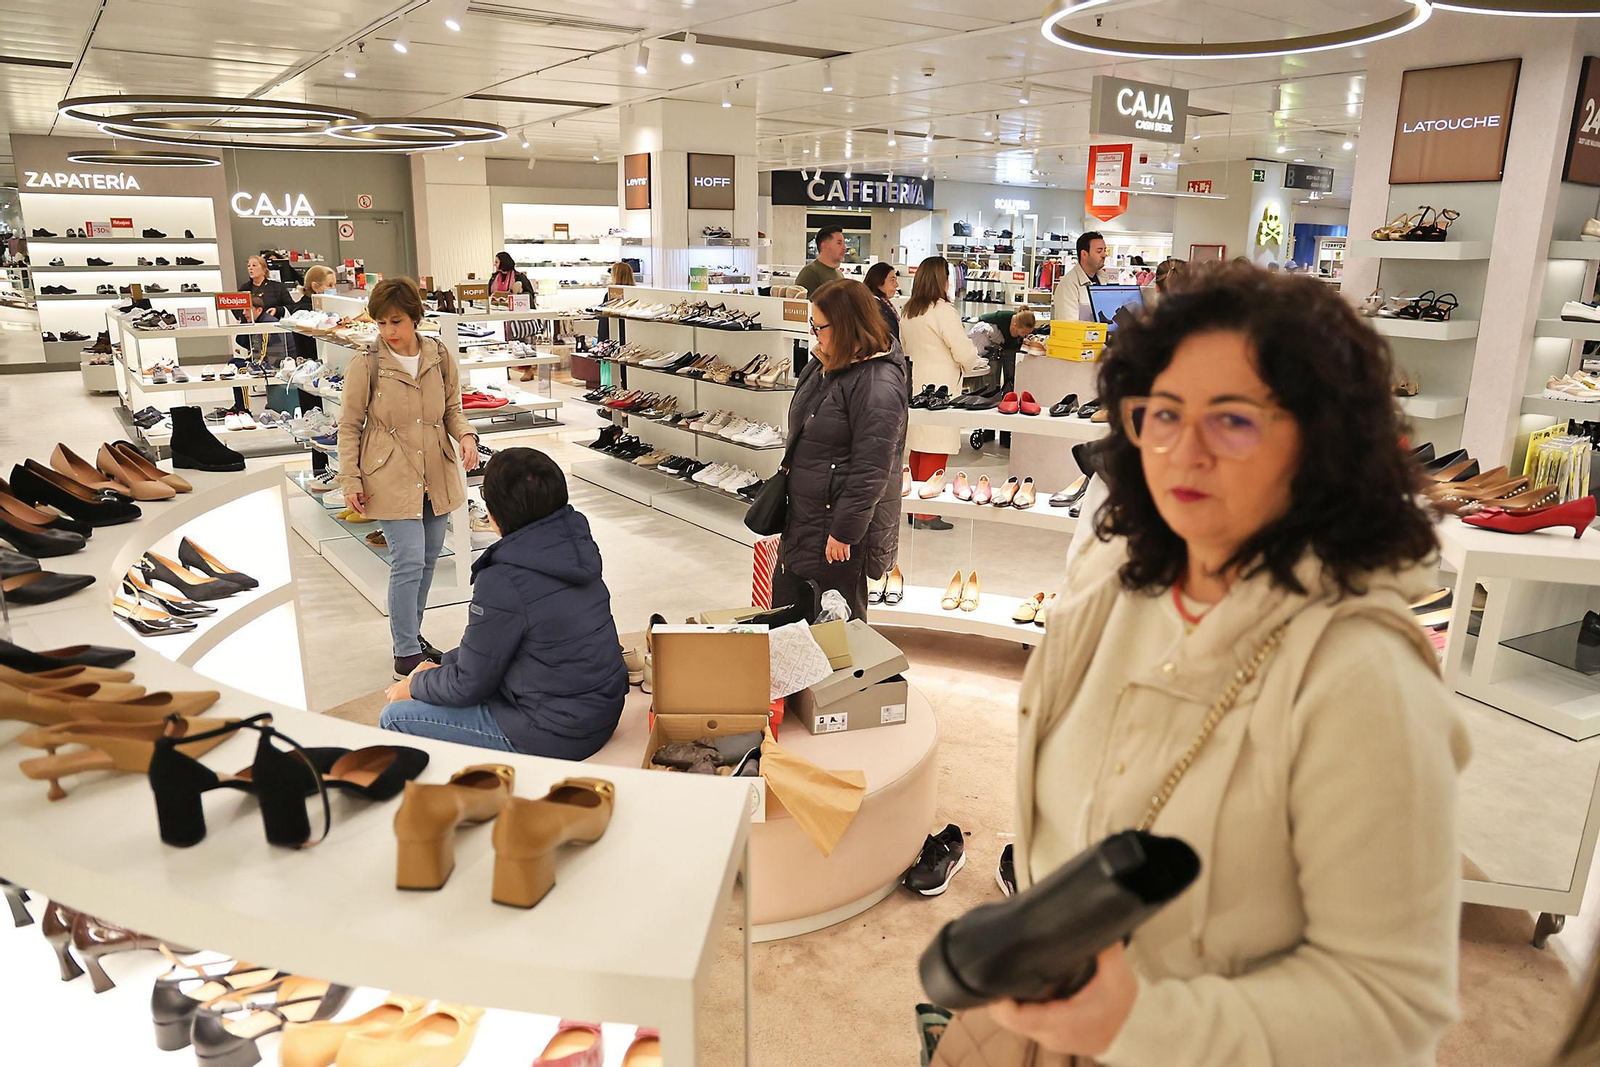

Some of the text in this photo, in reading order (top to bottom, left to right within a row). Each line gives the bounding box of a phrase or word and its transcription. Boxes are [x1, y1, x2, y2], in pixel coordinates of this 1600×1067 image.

[1117, 88, 1174, 122] CAJA
[1403, 115, 1500, 134] LATOUCHE
[24, 171, 140, 191] ZAPATERÍA
[694, 176, 731, 188] HOFF
[807, 178, 925, 206] CAFETERÍA
[231, 191, 315, 217] CAJA
[262, 217, 316, 228] CASH DESK
